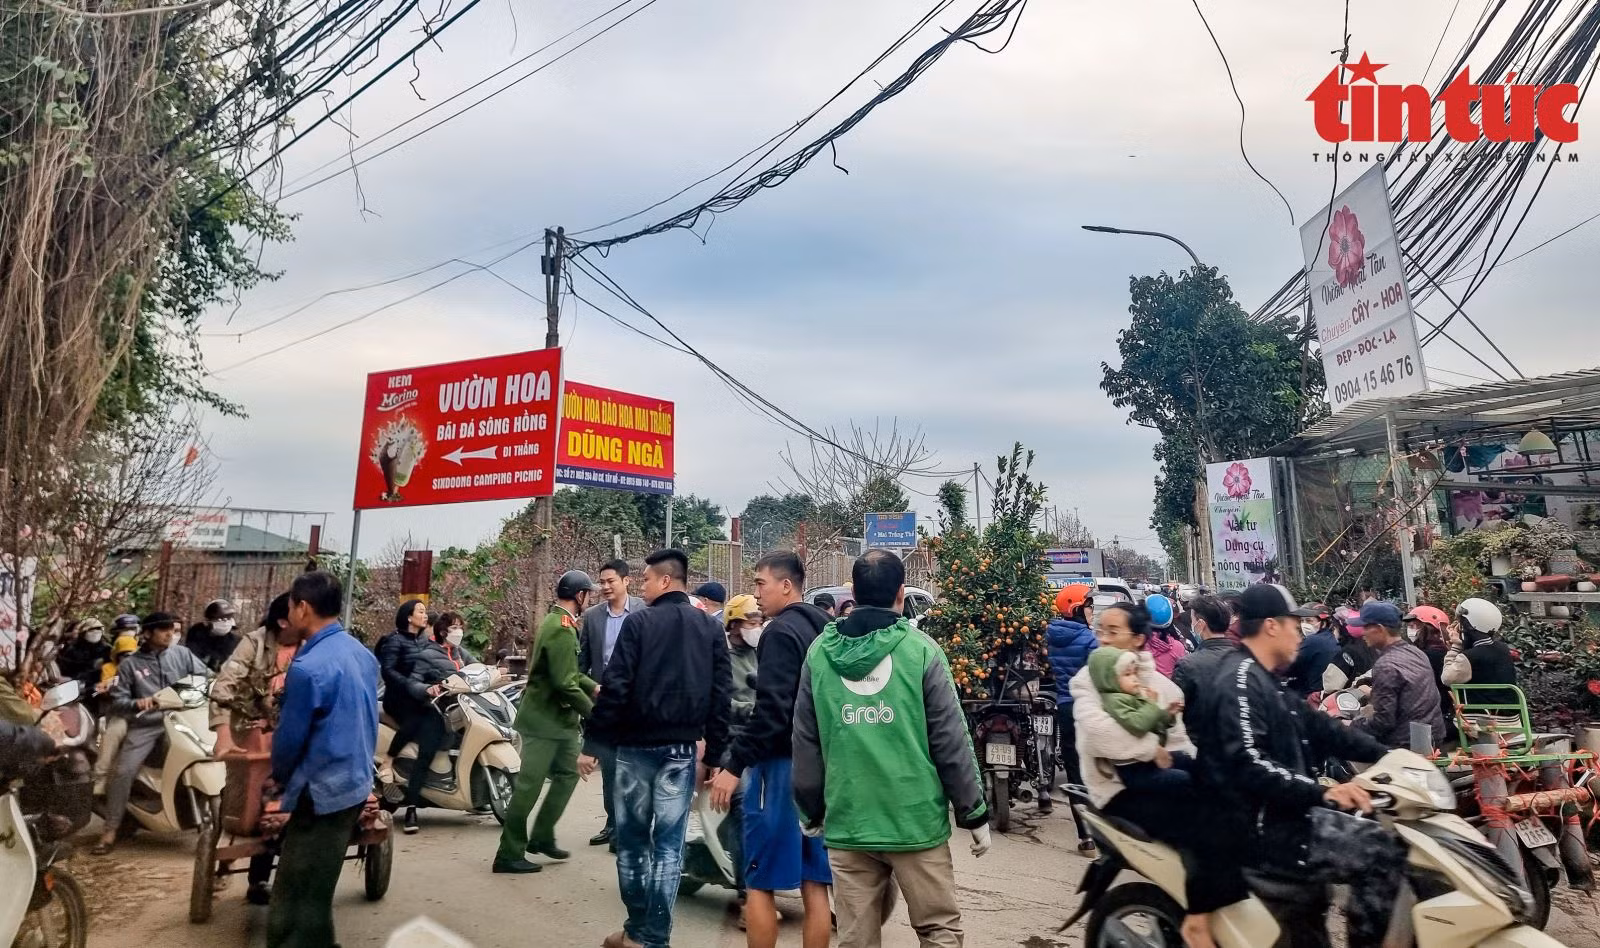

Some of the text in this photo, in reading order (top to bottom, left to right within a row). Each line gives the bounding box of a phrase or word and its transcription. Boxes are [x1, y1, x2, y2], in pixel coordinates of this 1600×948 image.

[1366, 253, 1386, 276] Tân
[1352, 299, 1370, 325] CÂY
[1381, 282, 1403, 310] HOA
[388, 374, 412, 389] KEM
[439, 370, 551, 413] VƯỜN HOA
[1335, 355, 1413, 403] 0904 15 46 76
[381, 388, 418, 407] Merino
[436, 409, 547, 441] BÃI ĐÁ SÔNG HỒNG
[584, 397, 600, 424] HOA
[619, 403, 634, 430] HOA
[635, 407, 649, 431] MAI
[567, 429, 664, 469] DŨNG NGÀ
[473, 472, 512, 486] CAMPING
[514, 469, 543, 483] PICNIC
[1225, 539, 1249, 554] Dụng
[1218, 559, 1240, 573] nông
[842, 700, 894, 725] Grab
